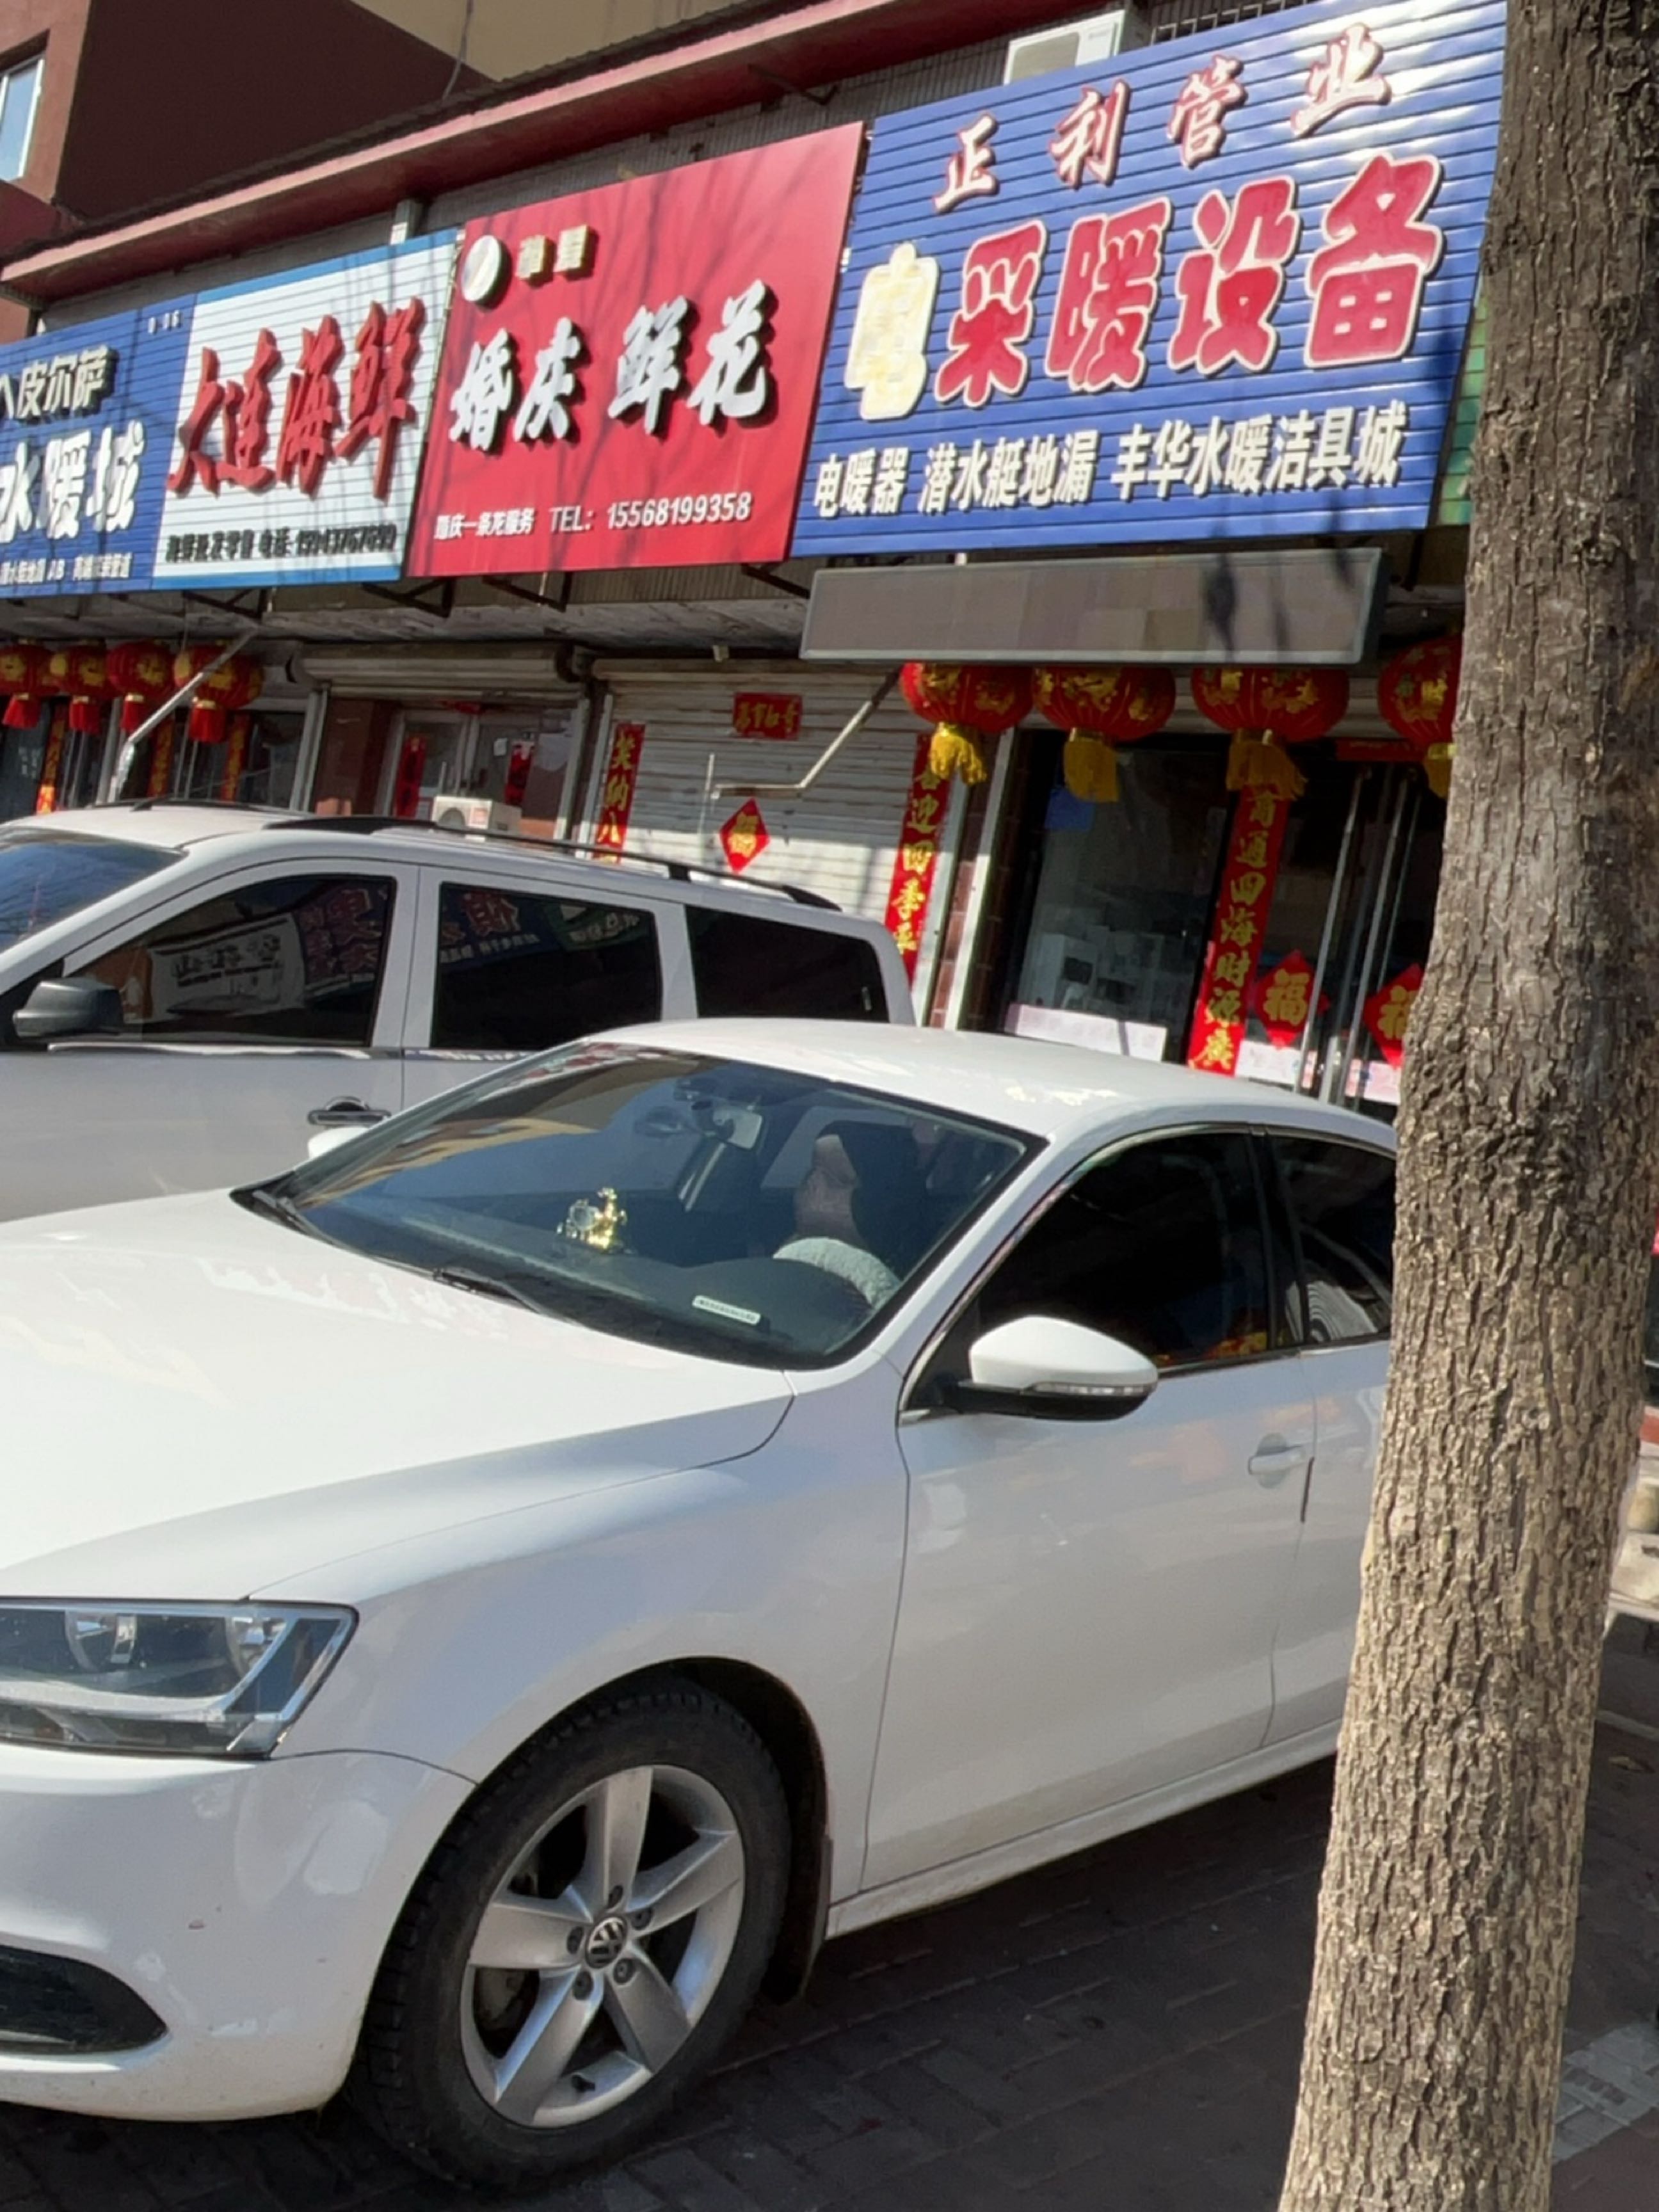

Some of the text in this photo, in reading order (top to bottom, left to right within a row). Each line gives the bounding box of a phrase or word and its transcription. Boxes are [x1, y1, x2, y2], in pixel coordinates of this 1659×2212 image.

[933, 23, 1392, 214] 正利管业
[844, 150, 1444, 420] 电采暖设备
[449, 279, 767, 451] 婚庆 鲜花
[607, 492, 753, 531] 15568199358
[814, 447, 908, 518] 电暖器
[918, 430, 1099, 514] 潜水艇地漏
[1110, 399, 1408, 502] 丰华水暖洁具城
[1262, 968, 1310, 1027] 福
